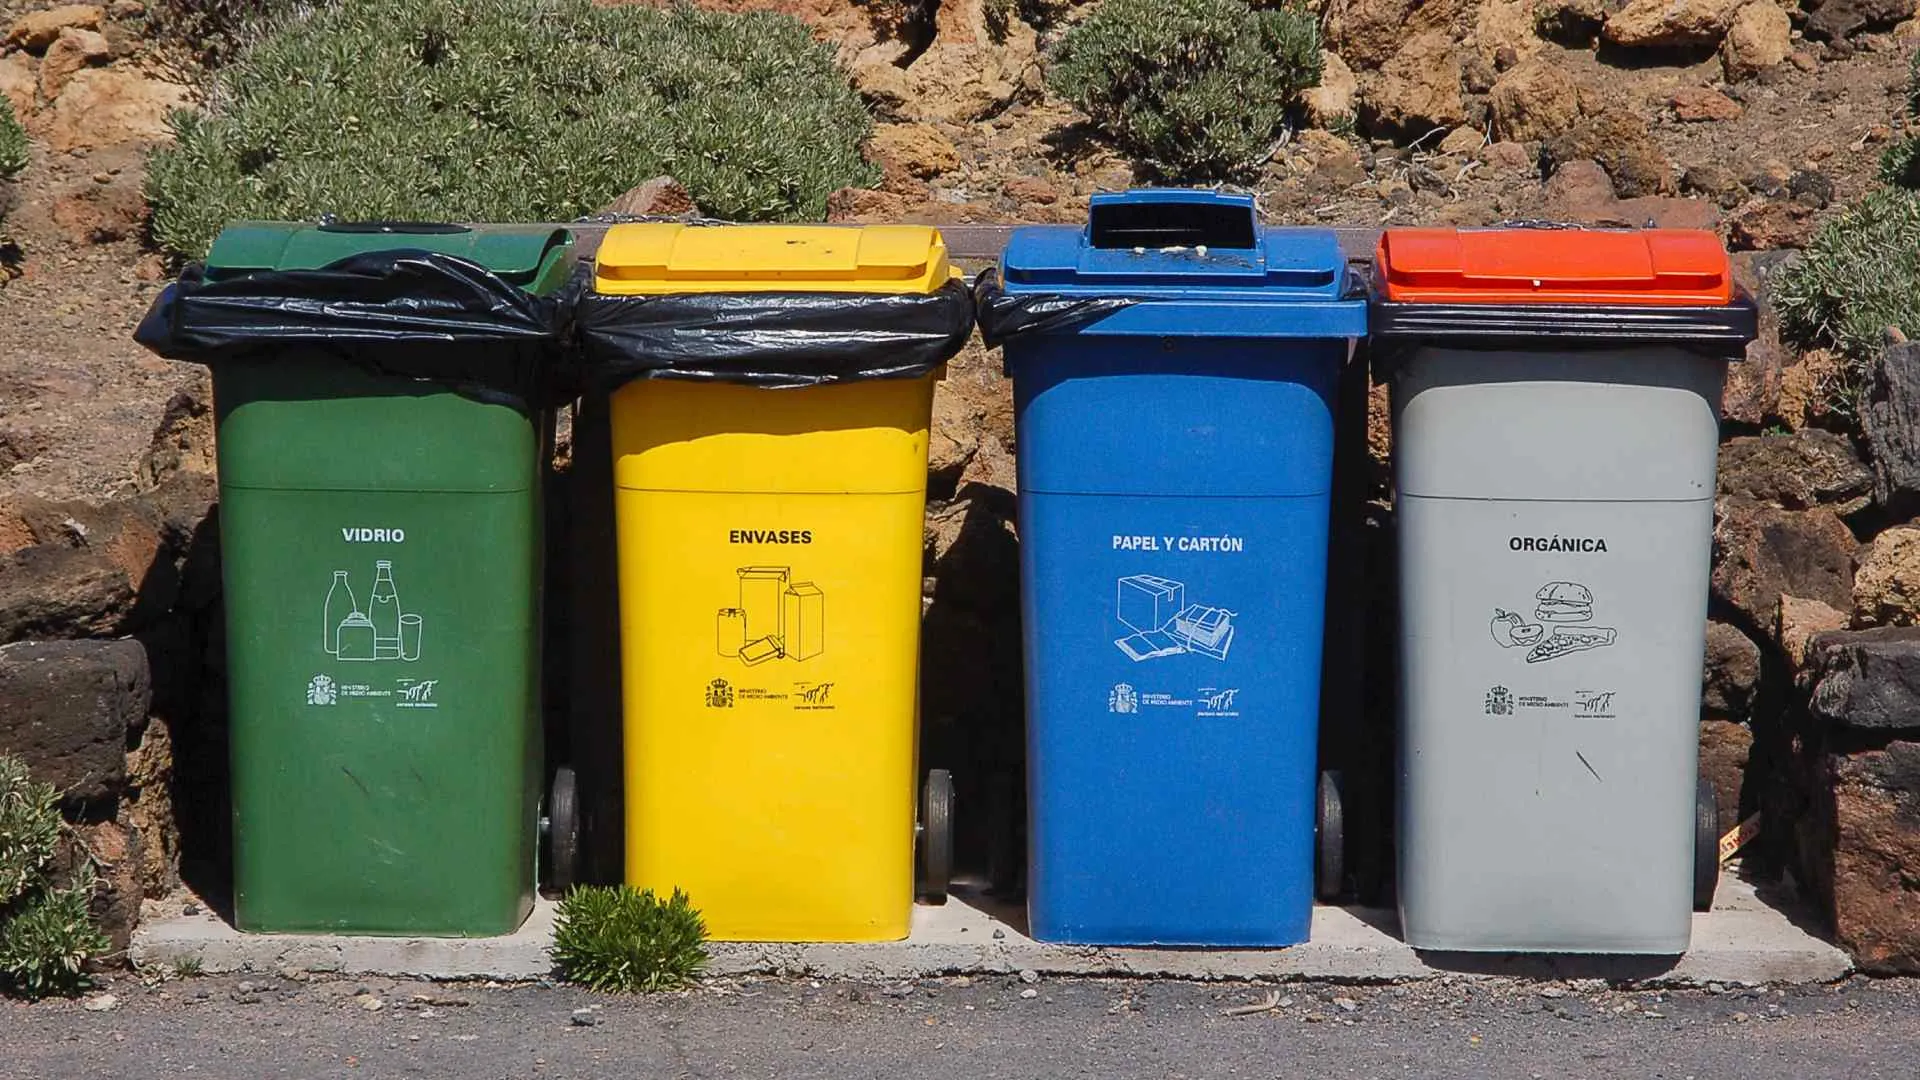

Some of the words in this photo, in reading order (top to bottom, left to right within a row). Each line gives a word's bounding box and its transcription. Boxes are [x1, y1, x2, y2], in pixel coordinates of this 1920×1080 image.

[342, 528, 405, 542] VIDRIO
[729, 530, 812, 544] ENVASES
[1112, 535, 1159, 551] PAPEL
[1163, 537, 1175, 551] Y
[1178, 534, 1243, 552] CARTÓN
[1509, 534, 1608, 552] ORGÁNICA
